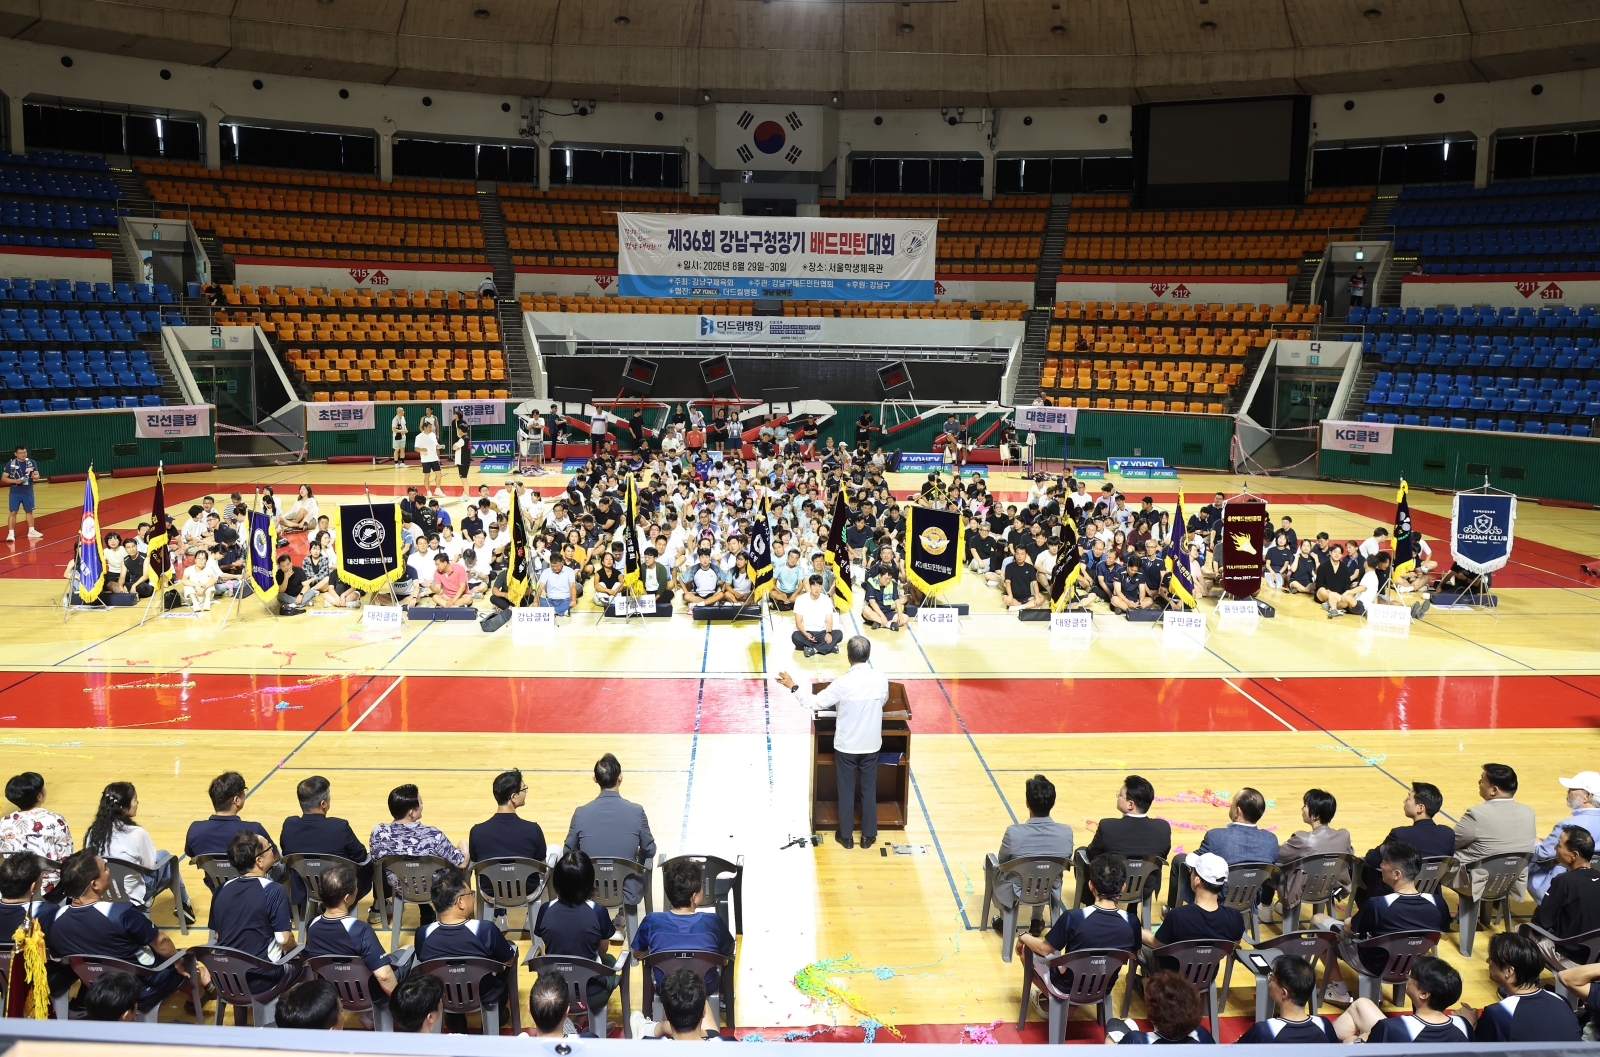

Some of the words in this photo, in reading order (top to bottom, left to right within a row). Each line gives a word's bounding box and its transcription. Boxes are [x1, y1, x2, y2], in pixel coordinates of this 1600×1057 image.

[667, 228, 717, 254] 제36회
[719, 229, 807, 256] 강남구청장기
[810, 231, 896, 257] 배드민턴대회
[683, 260, 703, 272] 일시:
[703, 260, 731, 272] 2026년
[732, 261, 746, 272] 8월
[747, 261, 788, 273] 29일~30일
[808, 262, 828, 273] 장소:
[828, 263, 884, 274] 서울학생체육관
[352, 268, 367, 278] 215
[372, 276, 387, 285] 315
[597, 275, 611, 284] 214
[674, 278, 691, 287] 주최:
[692, 278, 734, 287] 강남구체육회
[753, 279, 771, 288] 주관:
[771, 280, 834, 288] 강남구배드민턴협회
[869, 281, 891, 290] 강남구
[1152, 283, 1167, 291] 212
[1518, 282, 1536, 292] 211
[1174, 290, 1189, 298] 312
[1542, 289, 1561, 299] 311
[717, 320, 763, 331] 더드림병원
[210, 326, 222, 338] 라
[1310, 342, 1322, 354] 다
[318, 408, 364, 421] 초단클럽
[1026, 410, 1067, 424] 대청클럽
[147, 414, 197, 428] 진선클럽
[1335, 429, 1380, 443] KG클럽
[481, 443, 511, 454] YONEX
[367, 611, 399, 622] 대진클럽
[517, 612, 550, 622] 강남클럽
[1168, 616, 1202, 628] 구민클럽
[1055, 618, 1088, 628] 대왕클럽
